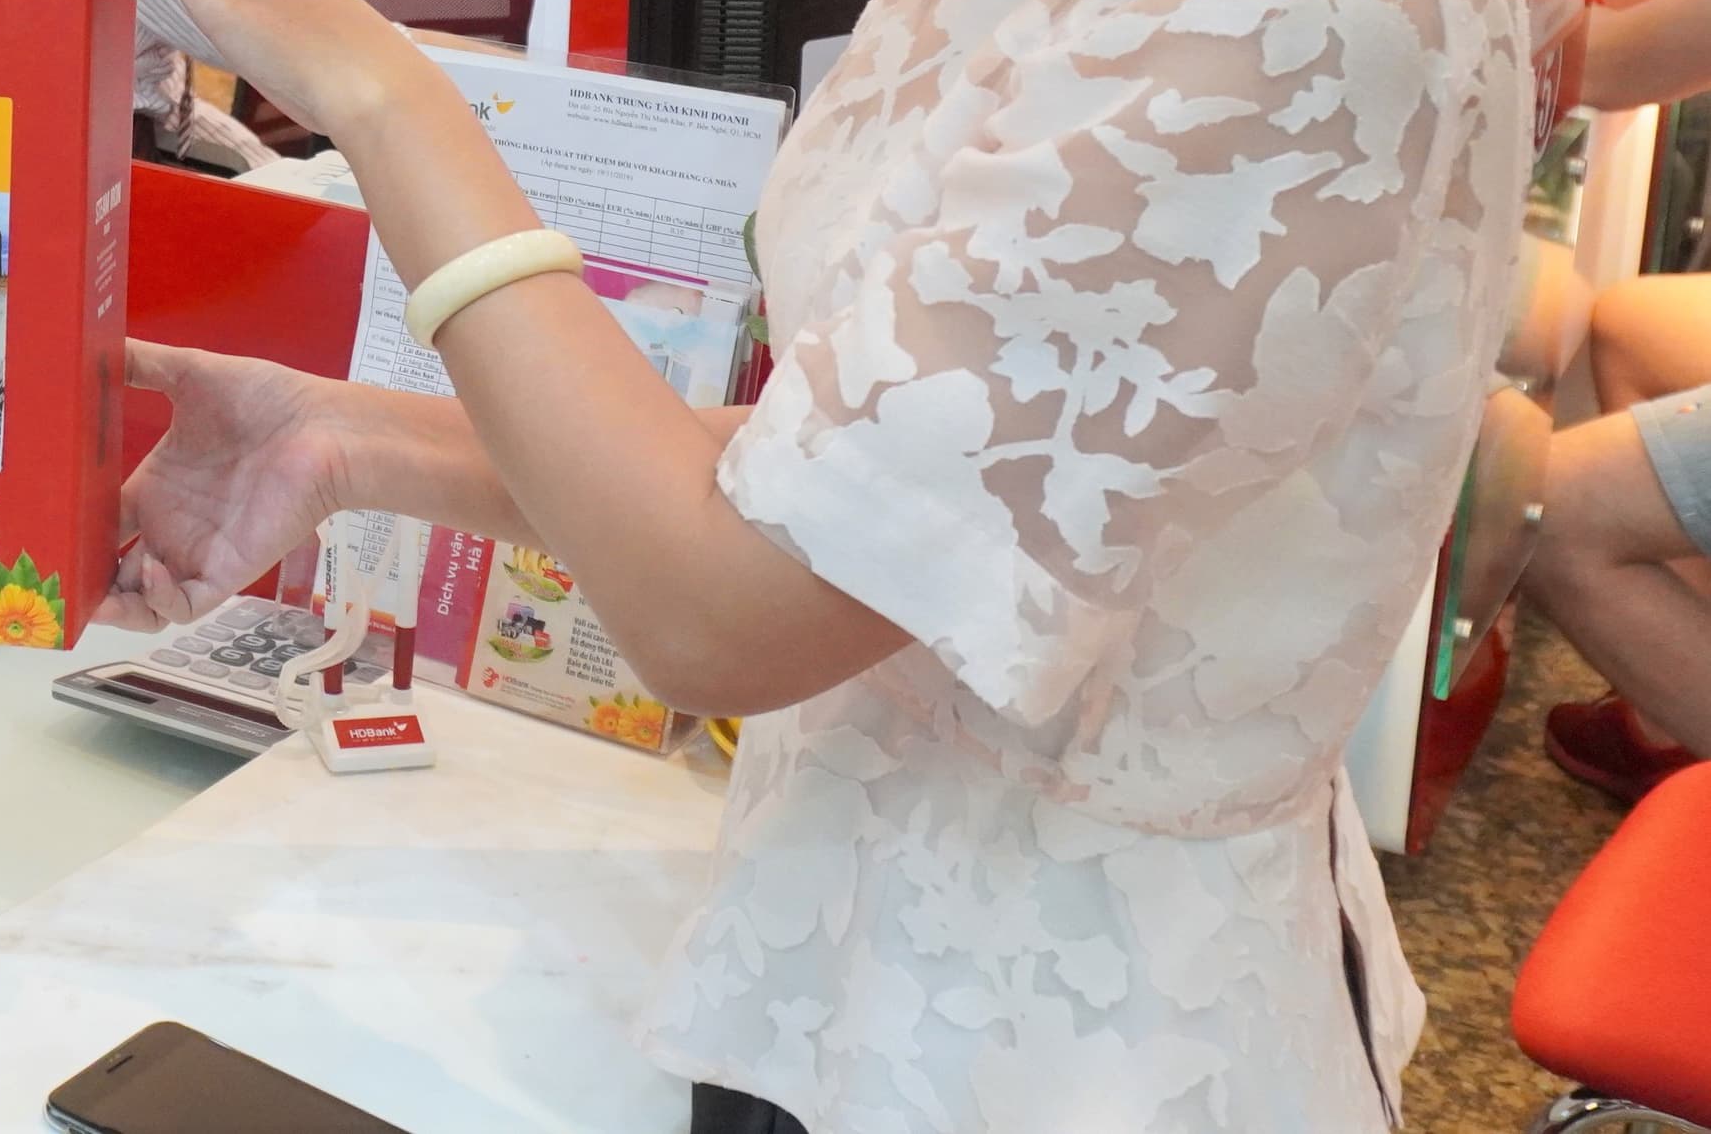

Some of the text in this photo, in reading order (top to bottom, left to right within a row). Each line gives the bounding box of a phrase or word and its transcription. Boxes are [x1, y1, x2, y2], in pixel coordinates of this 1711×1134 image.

[569, 88, 614, 104] HDBANK
[616, 96, 653, 111] TRUNG
[681, 106, 709, 120] KINH
[711, 112, 750, 126] DOANH
[466, 546, 483, 572] Hà
[436, 581, 455, 616] Dịch
[446, 560, 462, 579] vụ
[349, 726, 397, 739] HDBank
